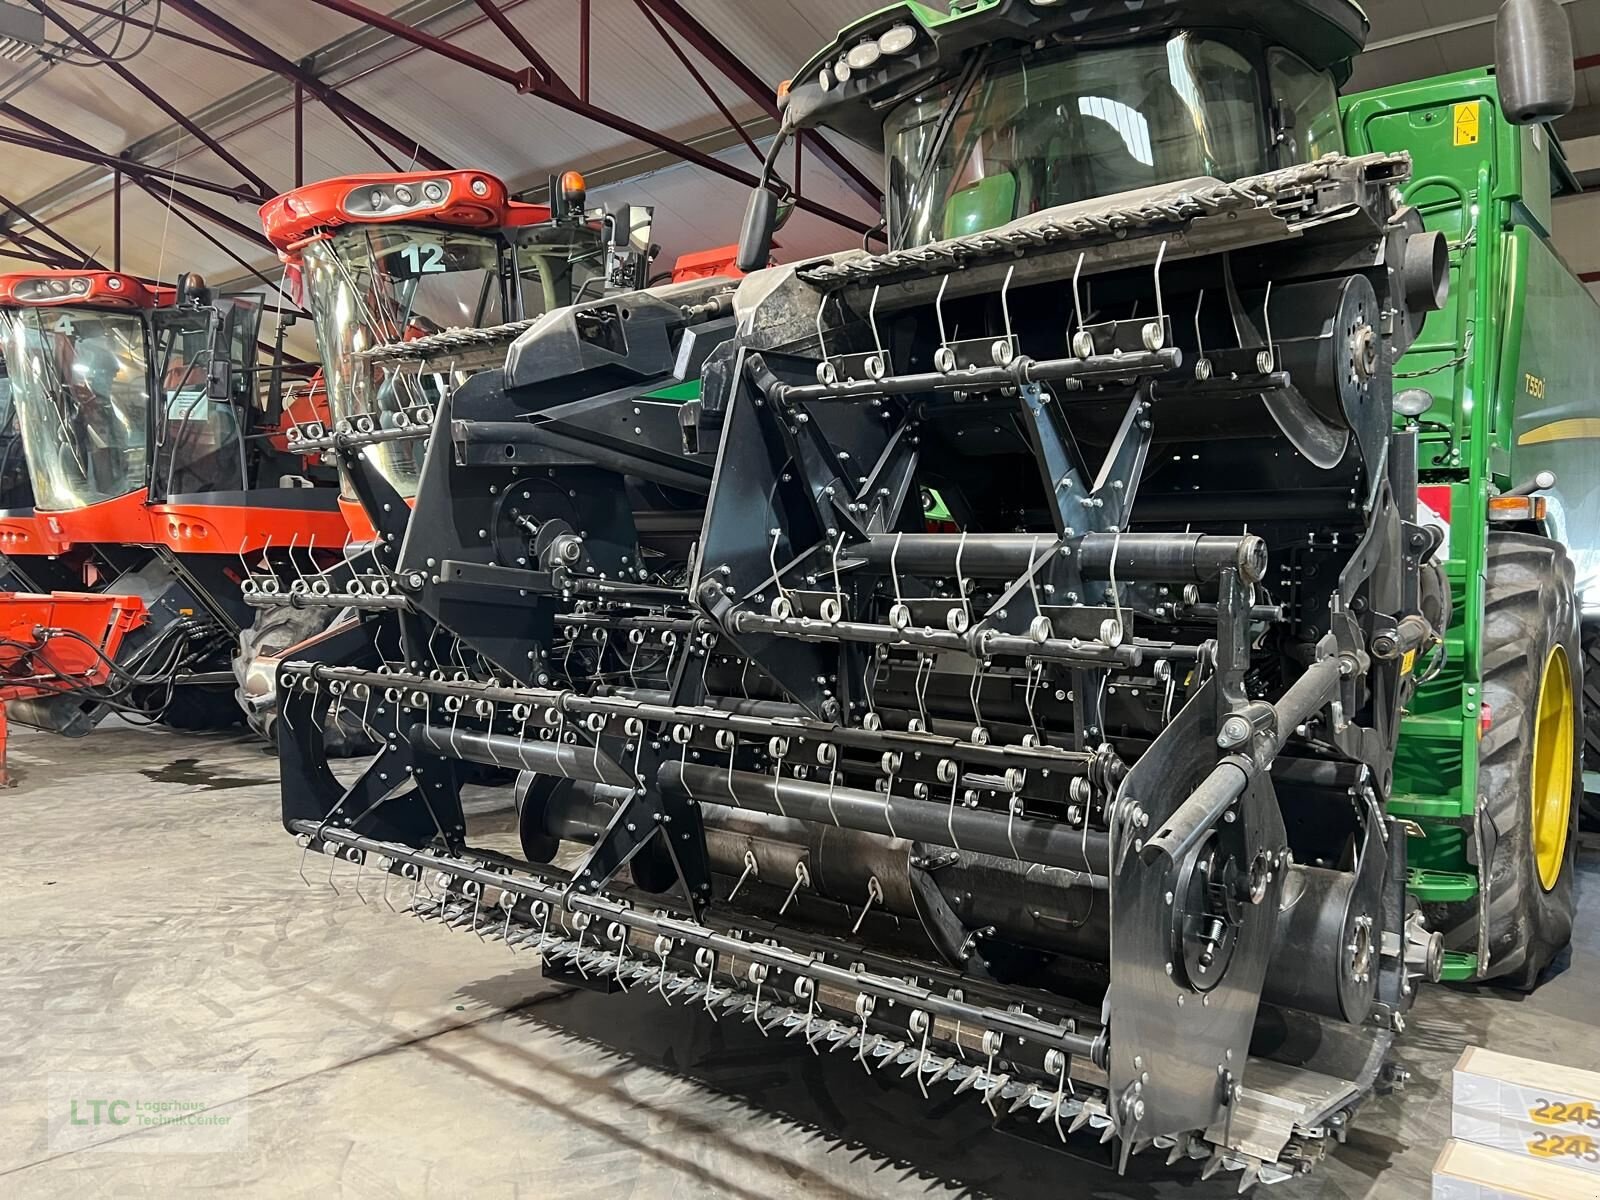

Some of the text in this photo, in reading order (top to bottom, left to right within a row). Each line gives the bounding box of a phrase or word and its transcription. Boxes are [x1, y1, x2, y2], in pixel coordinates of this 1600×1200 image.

[401, 243, 446, 272] 12
[54, 314, 75, 336] 4
[1525, 373, 1546, 399] T550i
[1534, 1097, 1600, 1130] 2245
[1531, 1130, 1600, 1163] 2245
